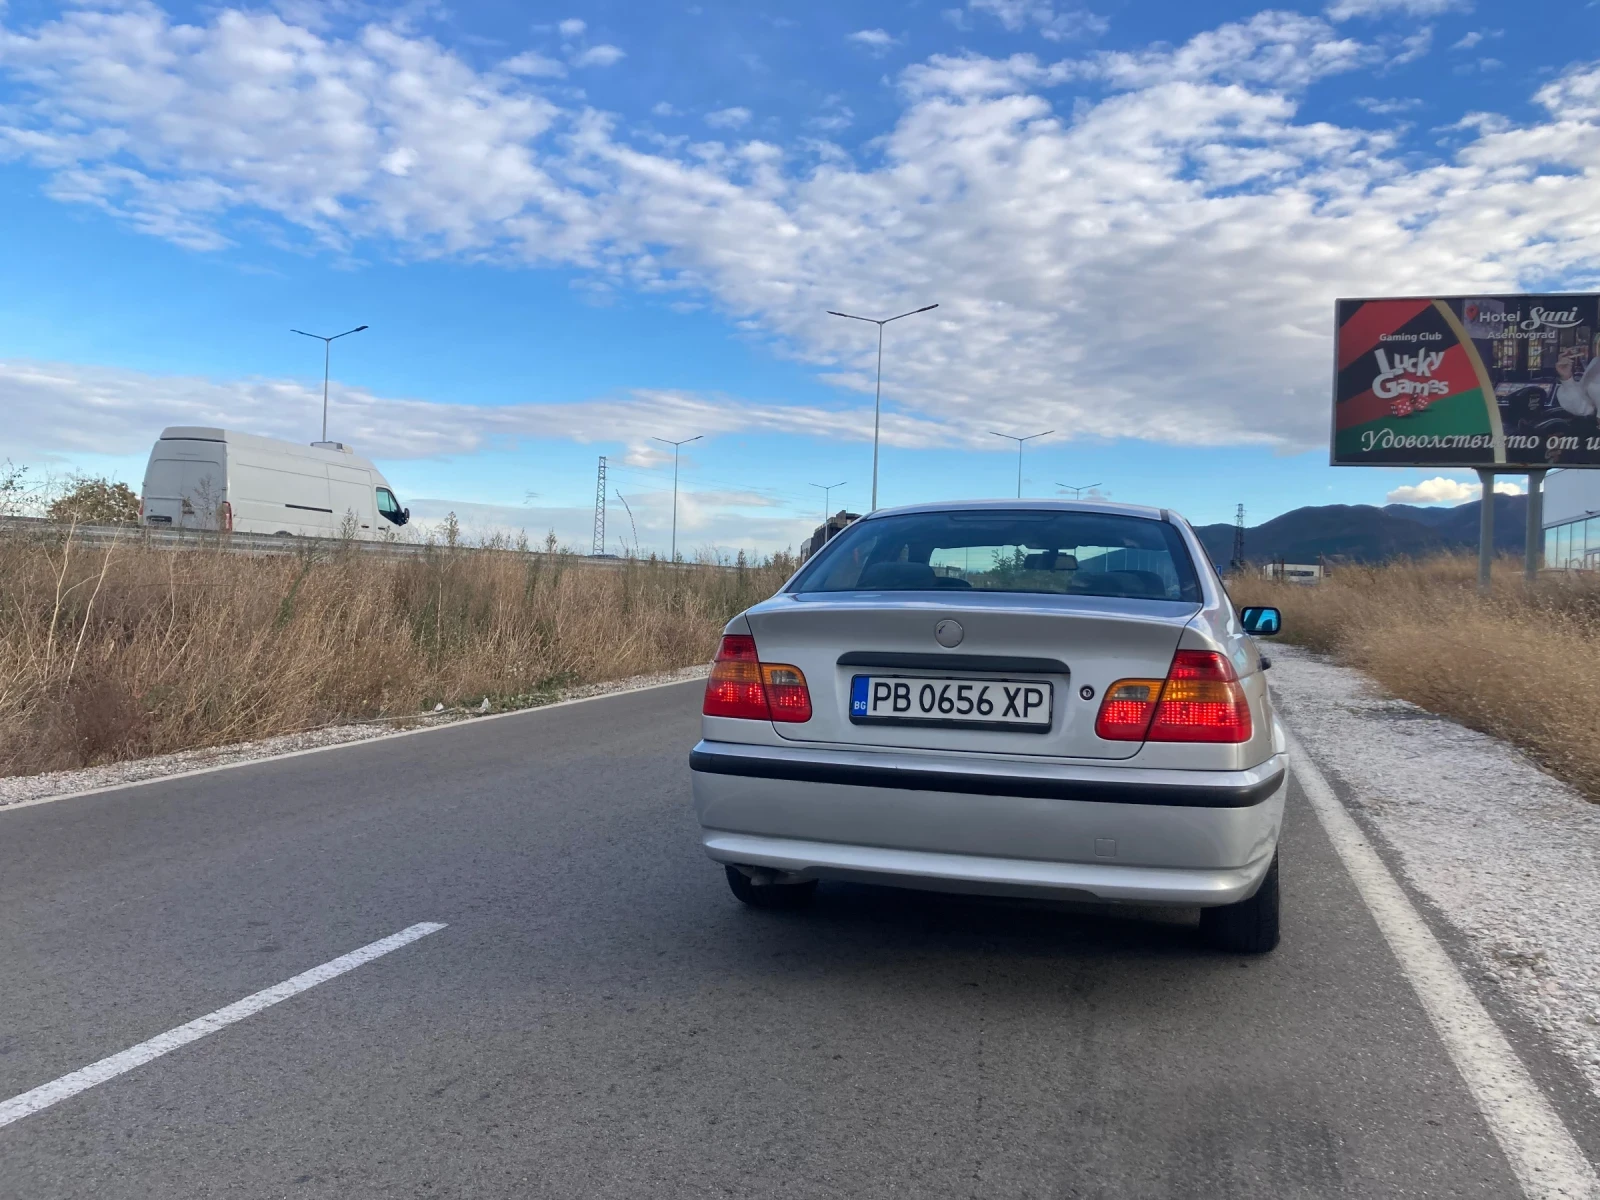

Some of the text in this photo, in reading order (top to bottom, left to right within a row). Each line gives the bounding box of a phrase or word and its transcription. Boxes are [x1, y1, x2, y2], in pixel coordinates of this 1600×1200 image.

[1479, 306, 1584, 330] Hotel Sani
[1379, 331, 1442, 343] Gaming Club
[1487, 330, 1556, 341] Asenovgrad
[1373, 347, 1445, 377] Lucky
[1372, 371, 1449, 399] Games
[1546, 435, 1579, 450] от
[853, 682, 1044, 718] BG PB 0656 XP
